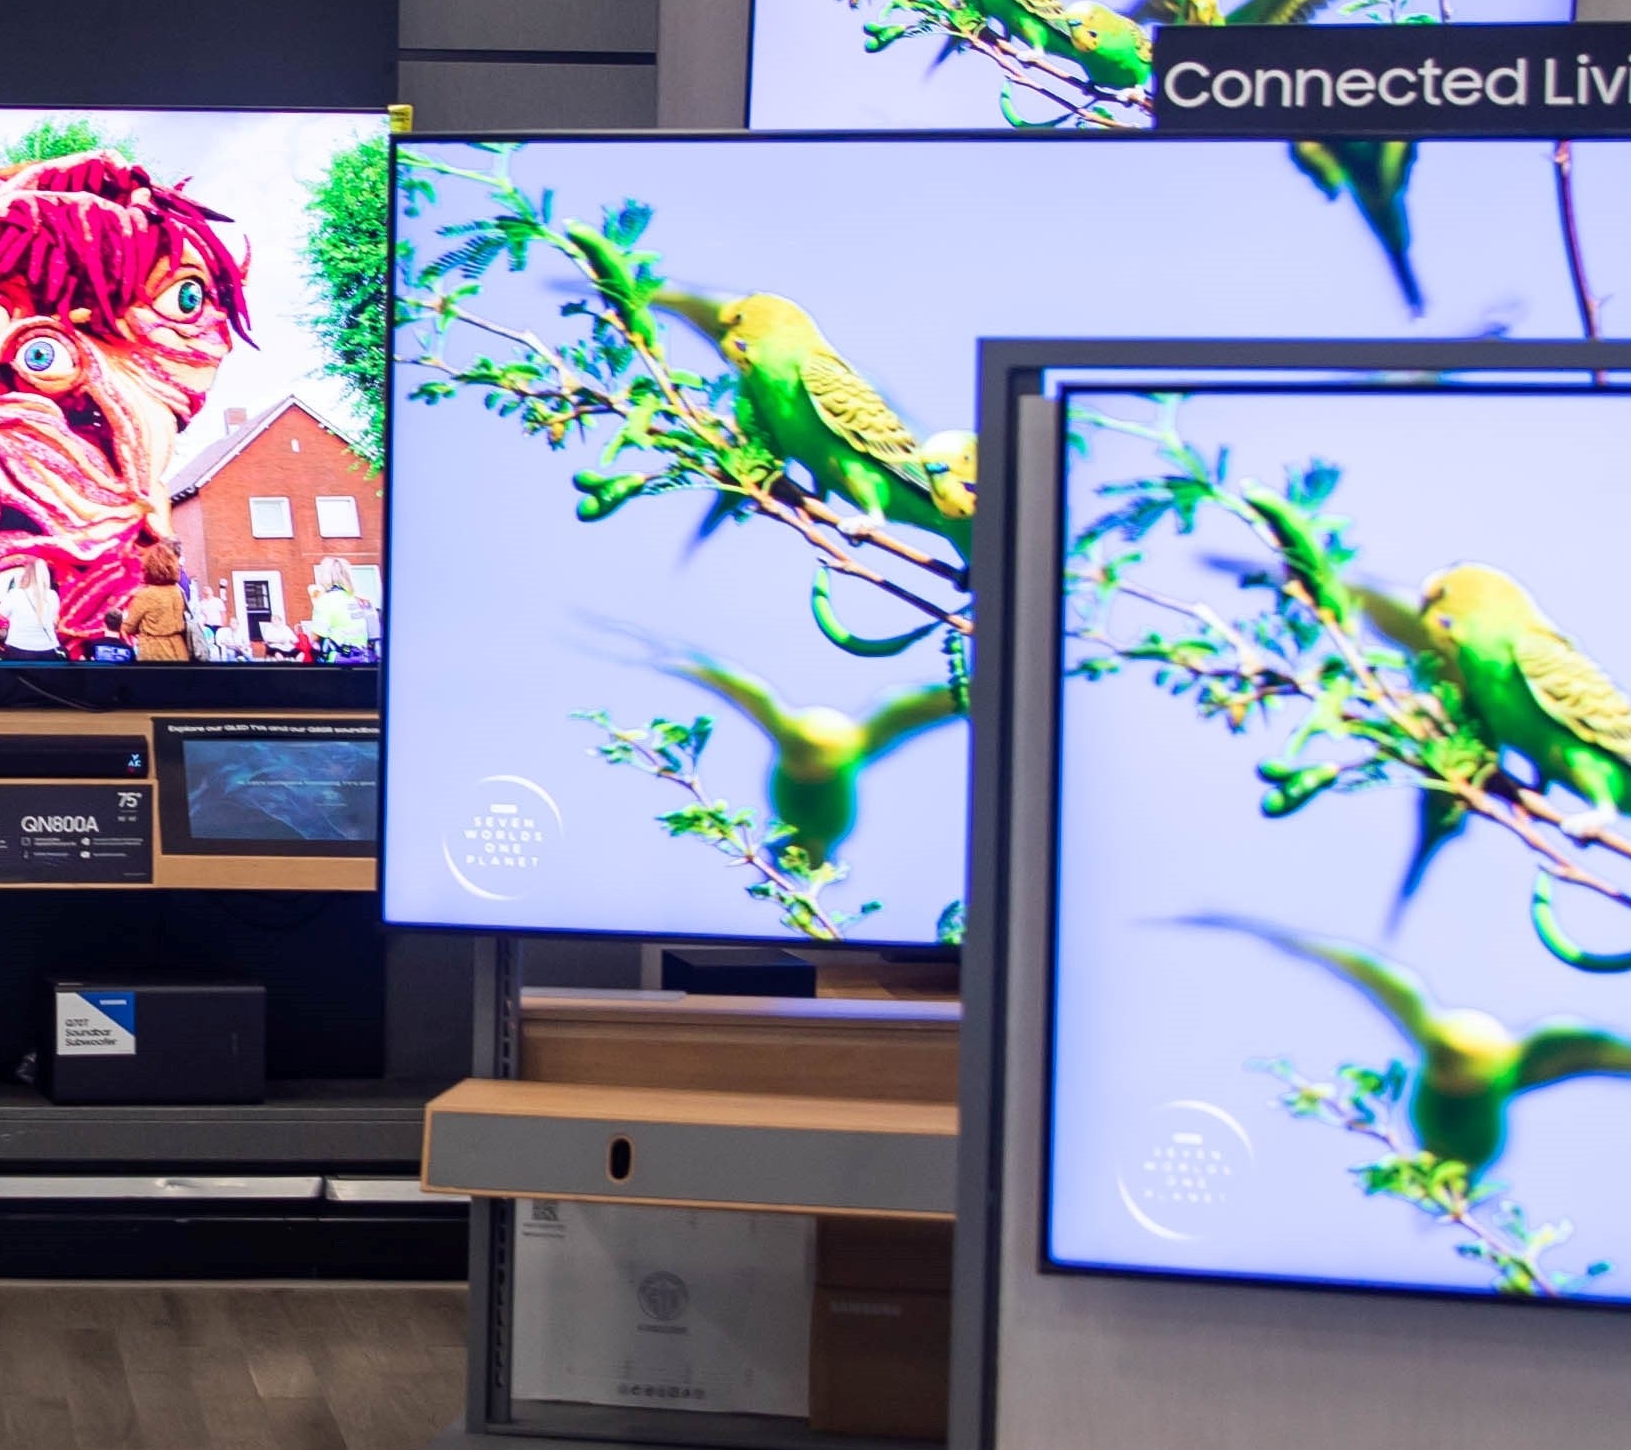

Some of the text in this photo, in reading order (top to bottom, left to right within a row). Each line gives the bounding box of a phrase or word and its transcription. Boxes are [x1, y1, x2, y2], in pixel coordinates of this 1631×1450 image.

[1163, 58, 1527, 110] Connected
[21, 815, 100, 833] QN800A
[473, 815, 535, 828] SEVEN
[463, 829, 544, 843] WORLDS
[484, 842, 522, 854] ONE
[465, 854, 539, 867] PLANET
